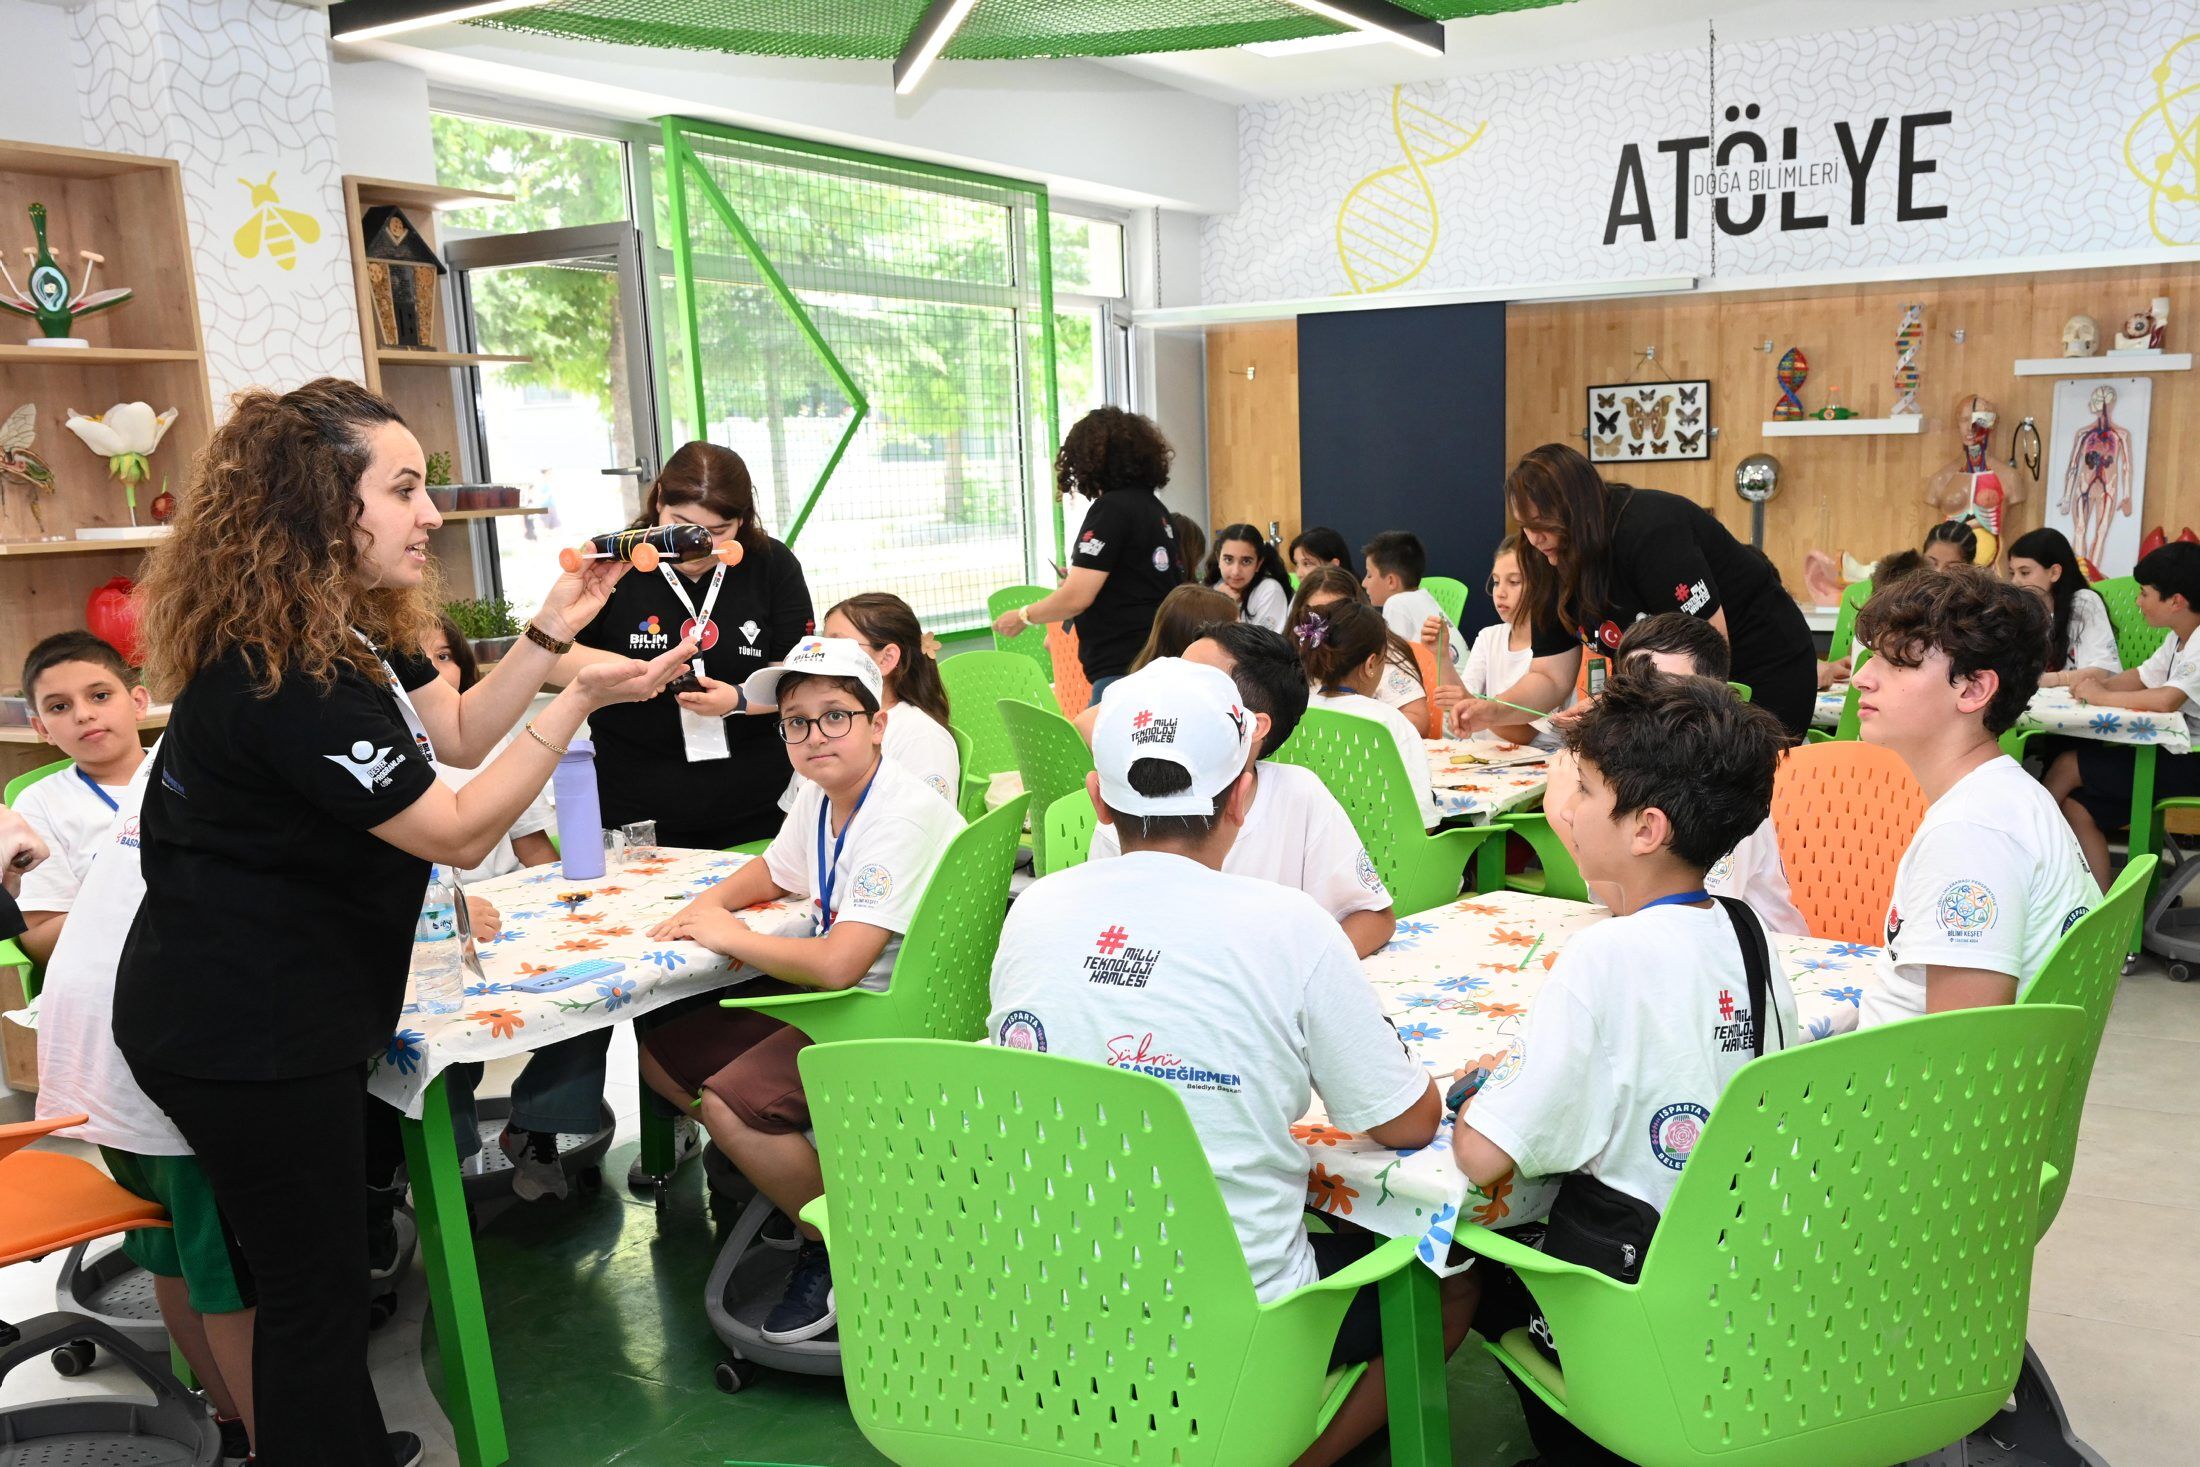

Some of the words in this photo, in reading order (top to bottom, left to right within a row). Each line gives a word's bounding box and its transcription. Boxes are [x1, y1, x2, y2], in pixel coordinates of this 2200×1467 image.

[1603, 103, 1952, 245] ATÖLYE
[1694, 168, 1741, 196] DOĞA
[1748, 156, 1839, 192] BİLİMLERİ
[1007, 1012, 1039, 1028] ISPARTA
[1187, 1083, 1215, 1091] Belediye
[1659, 1104, 1702, 1119] ISPARTA
